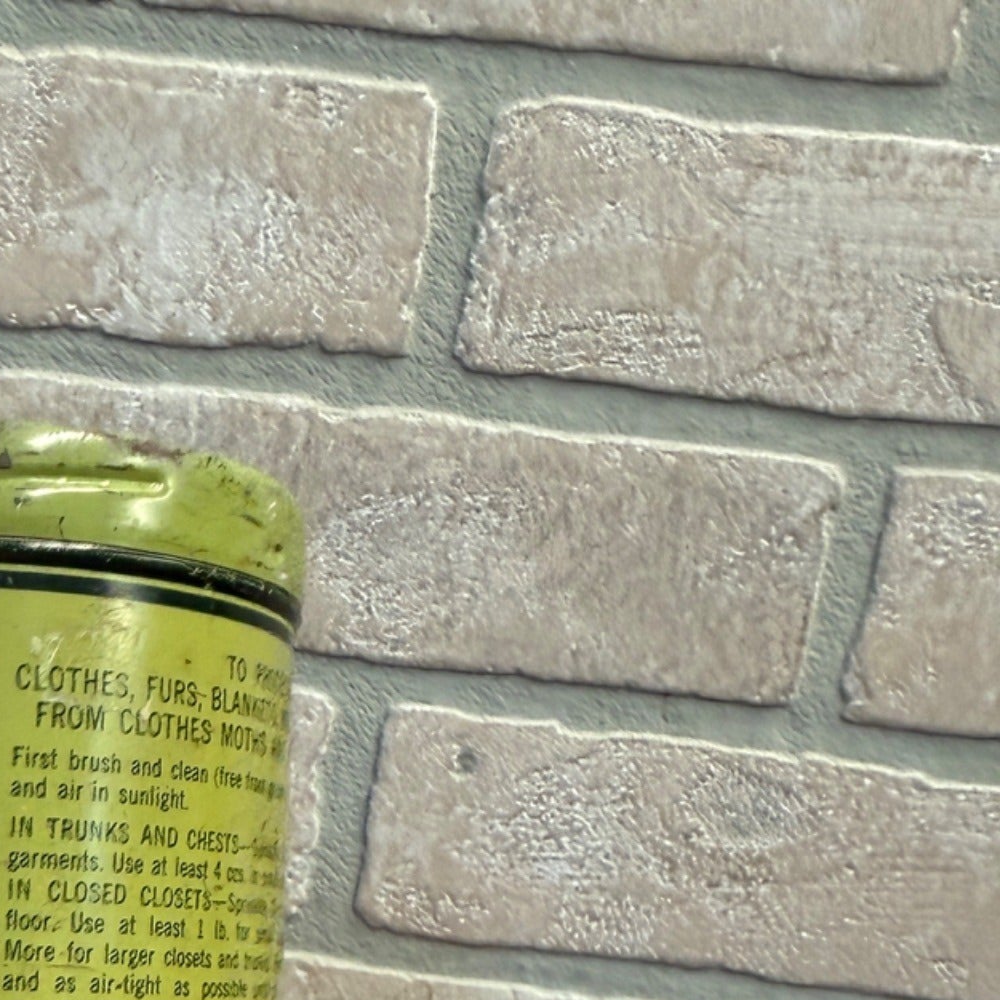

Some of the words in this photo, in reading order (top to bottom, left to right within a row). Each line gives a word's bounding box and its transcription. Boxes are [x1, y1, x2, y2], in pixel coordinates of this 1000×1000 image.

[15, 663, 135, 704] CLOTHES,
[227, 654, 248, 683] TO
[35, 700, 106, 731] FROM
[119, 708, 214, 746] CLOTHES
[11, 745, 58, 770] First
[68, 749, 121, 774] brush
[130, 757, 163, 779] and
[170, 760, 210, 784] clean
[9, 776, 47, 799] and
[56, 779, 84, 801] air
[91, 780, 109, 802] in
[118, 785, 189, 813] sunlight.
[8, 815, 35, 839] IN
[46, 817, 131, 846] TRUNKS
[139, 824, 179, 849] AND
[5, 850, 104, 874] garments.
[111, 852, 145, 876] Use
[151, 857, 168, 878] at
[174, 856, 209, 880] least
[6, 877, 32, 902] IN
[47, 879, 128, 906] CLOSED
[4, 908, 58, 934] floor.
[69, 910, 106, 935] Use
[117, 916, 138, 937] at
[149, 916, 187, 940] least
[213, 919, 231, 942] lb.
[3, 938, 56, 964] More
[65, 940, 96, 966] for
[103, 942, 155, 971] larger
[163, 946, 212, 970] closets
[1, 970, 40, 994] and
[54, 974, 77, 995] as
[88, 972, 162, 1000] air-tight
[173, 979, 191, 998] as
